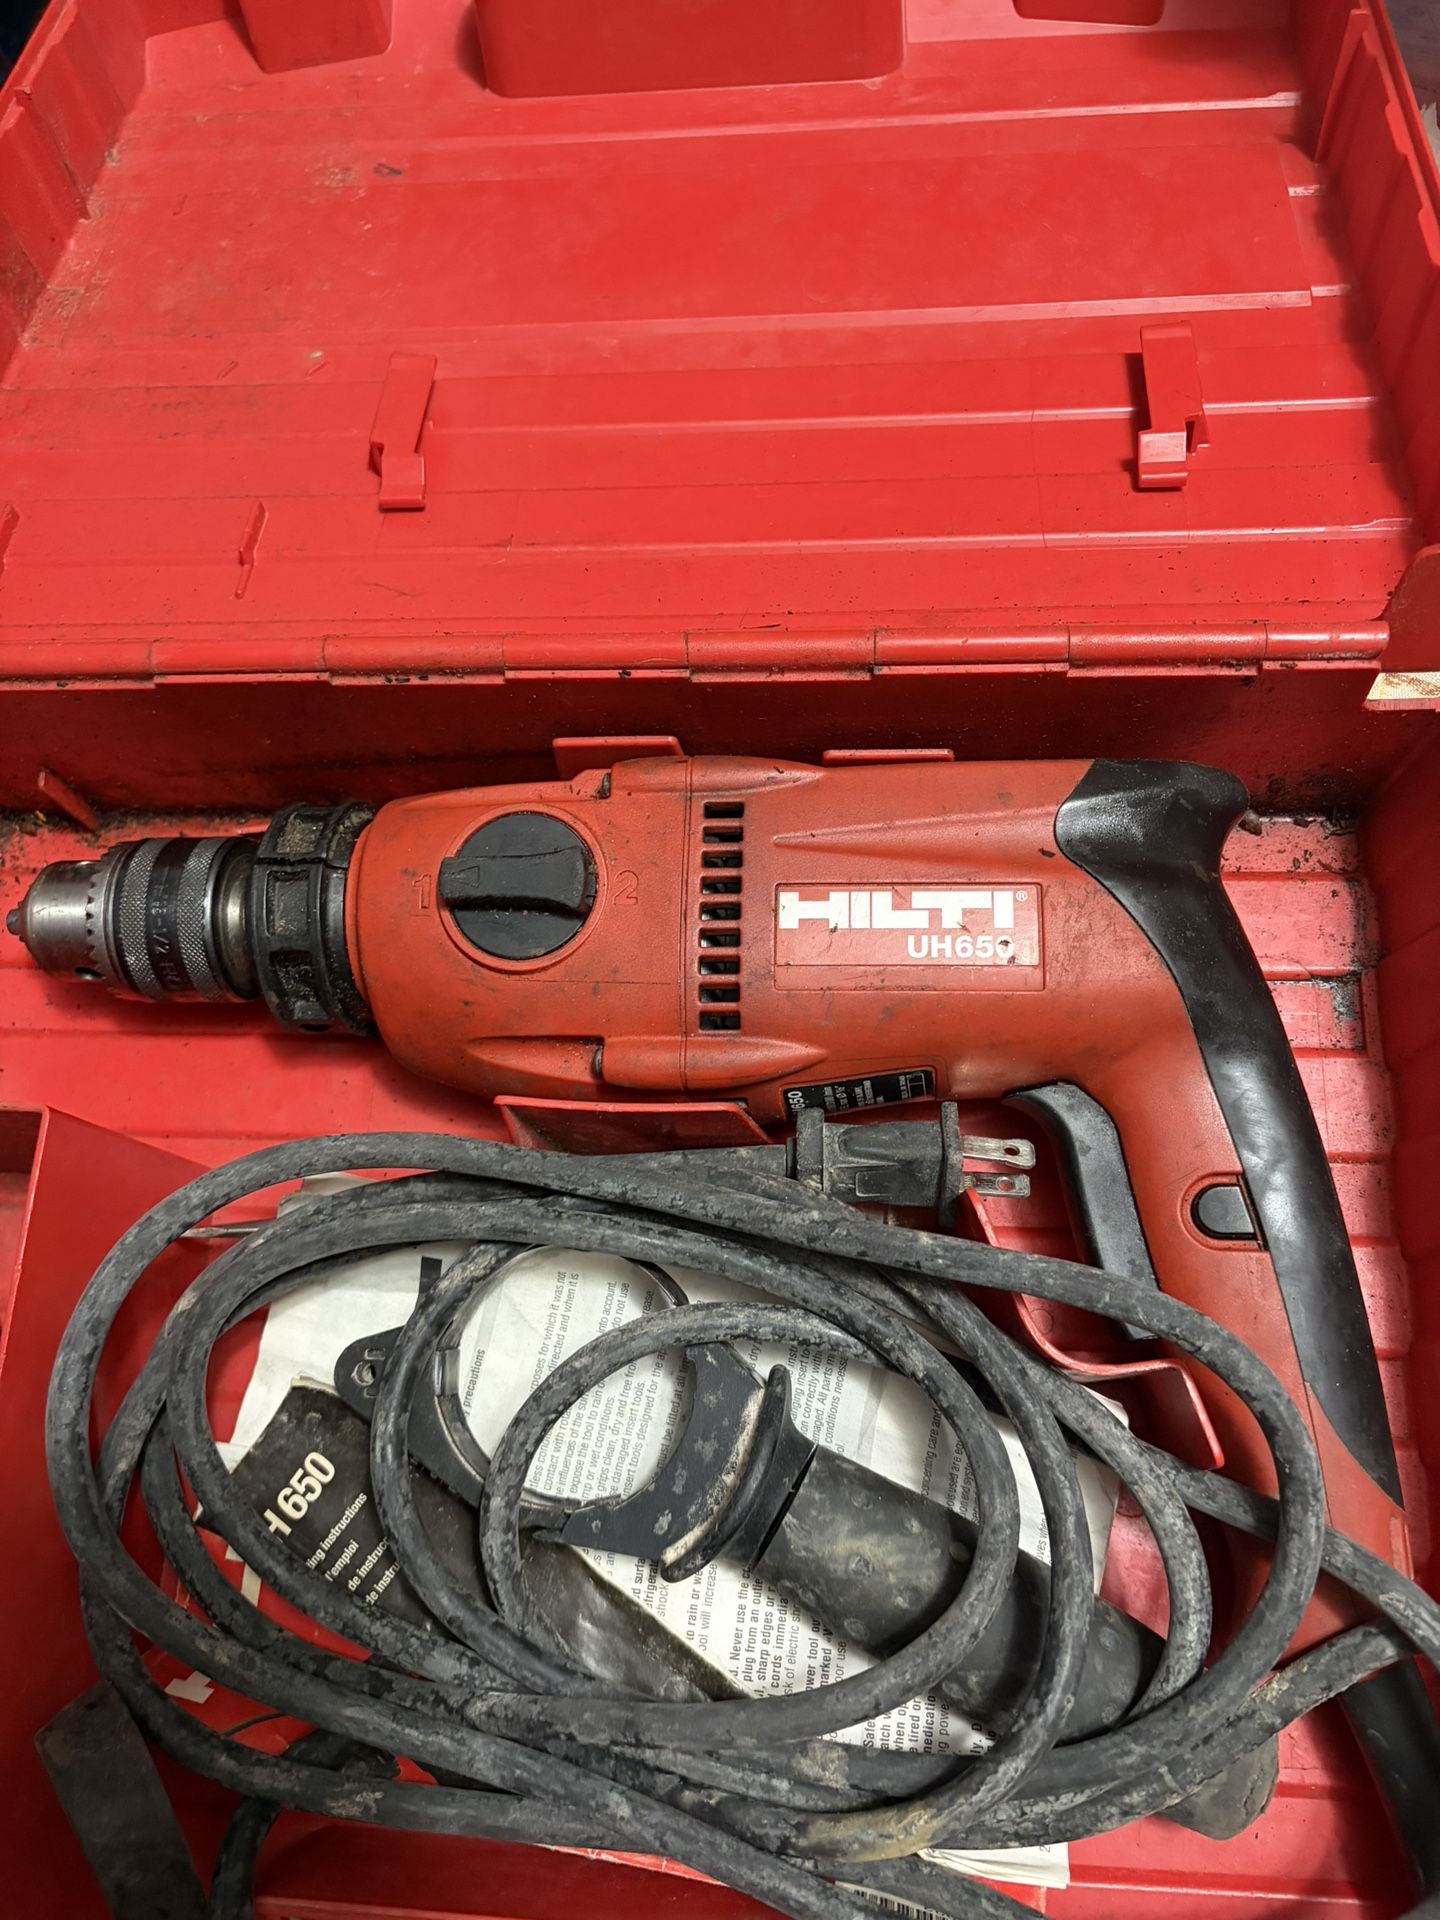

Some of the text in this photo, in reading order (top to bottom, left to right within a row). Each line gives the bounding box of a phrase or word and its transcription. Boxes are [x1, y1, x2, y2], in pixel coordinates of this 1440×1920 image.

[412, 874, 431, 909] 1
[614, 869, 639, 906] 2
[779, 891, 1014, 929] HILTI
[907, 935, 1015, 958] UH650
[556, 1270, 567, 1284] not
[570, 1272, 580, 1280] is
[552, 1283, 564, 1302] was
[561, 1287, 576, 1313] when
[617, 1282, 630, 1299] use
[548, 1302, 559, 1310] it
[614, 1298, 626, 1315] not
[543, 1311, 558, 1340] which
[558, 1313, 570, 1332] and
[537, 1340, 550, 1356] for
[462, 1347, 486, 1408] precautions
[650, 1361, 664, 1378] the
[794, 1359, 809, 1386] insert
[820, 1366, 834, 1392] parts
[618, 1378, 633, 1398] free
[646, 1378, 659, 1394] for
[675, 1374, 687, 1388] all
[591, 1389, 604, 1409] rain
[672, 1388, 683, 1400] at
[801, 1374, 821, 1419] correctly
[817, 1391, 829, 1405] All
[586, 1409, 598, 1421] to
[615, 1398, 628, 1418] and
[635, 1394, 656, 1441] designed
[664, 1400, 680, 1426] fitted
[823, 1394, 841, 1444] conditions
[929, 1407, 943, 1427] and
[571, 1411, 584, 1428] the
[593, 1394, 616, 1449] conditions.
[607, 1417, 624, 1436] dry
[568, 1427, 580, 1439] of
[581, 1421, 594, 1441] tool
[660, 1426, 674, 1442] be
[926, 1427, 939, 1450] care
[576, 1441, 589, 1458] the
[602, 1437, 619, 1466] clean,
[610, 1436, 631, 1484] damaged
[623, 1407, 639, 1436] insert
[628, 1441, 644, 1467] tools
[655, 1442, 671, 1469] must
[542, 1453, 560, 1491] contact
[552, 1431, 566, 1453] with
[555, 1439, 577, 1486] influences
[588, 1448, 601, 1468] wet
[950, 1455, 962, 1472] are
[568, 1459, 585, 1494] expose
[585, 1468, 594, 1480] or
[596, 1465, 610, 1492] grips
[277, 1451, 336, 1521] 650
[320, 1491, 368, 1552] instructions
[347, 1577, 362, 1592] de
[690, 1587, 701, 1600] or
[701, 1561, 718, 1607] increase
[736, 1580, 750, 1600] the
[765, 1594, 775, 1607] or
[686, 1603, 699, 1626] rain
[699, 1610, 711, 1630] will
[735, 1603, 747, 1623] use
[749, 1608, 760, 1623] an
[760, 1610, 774, 1645] edges
[728, 1626, 744, 1661] Never
[743, 1626, 758, 1653] from
[784, 1624, 800, 1665] electric
[806, 1636, 819, 1660] tool
[836, 1640, 847, 1661] use
[740, 1656, 757, 1683] plug
[755, 1648, 771, 1681] sharp
[770, 1654, 783, 1688] cords
[783, 1665, 795, 1679] of
[907, 1714, 920, 1742] tired
